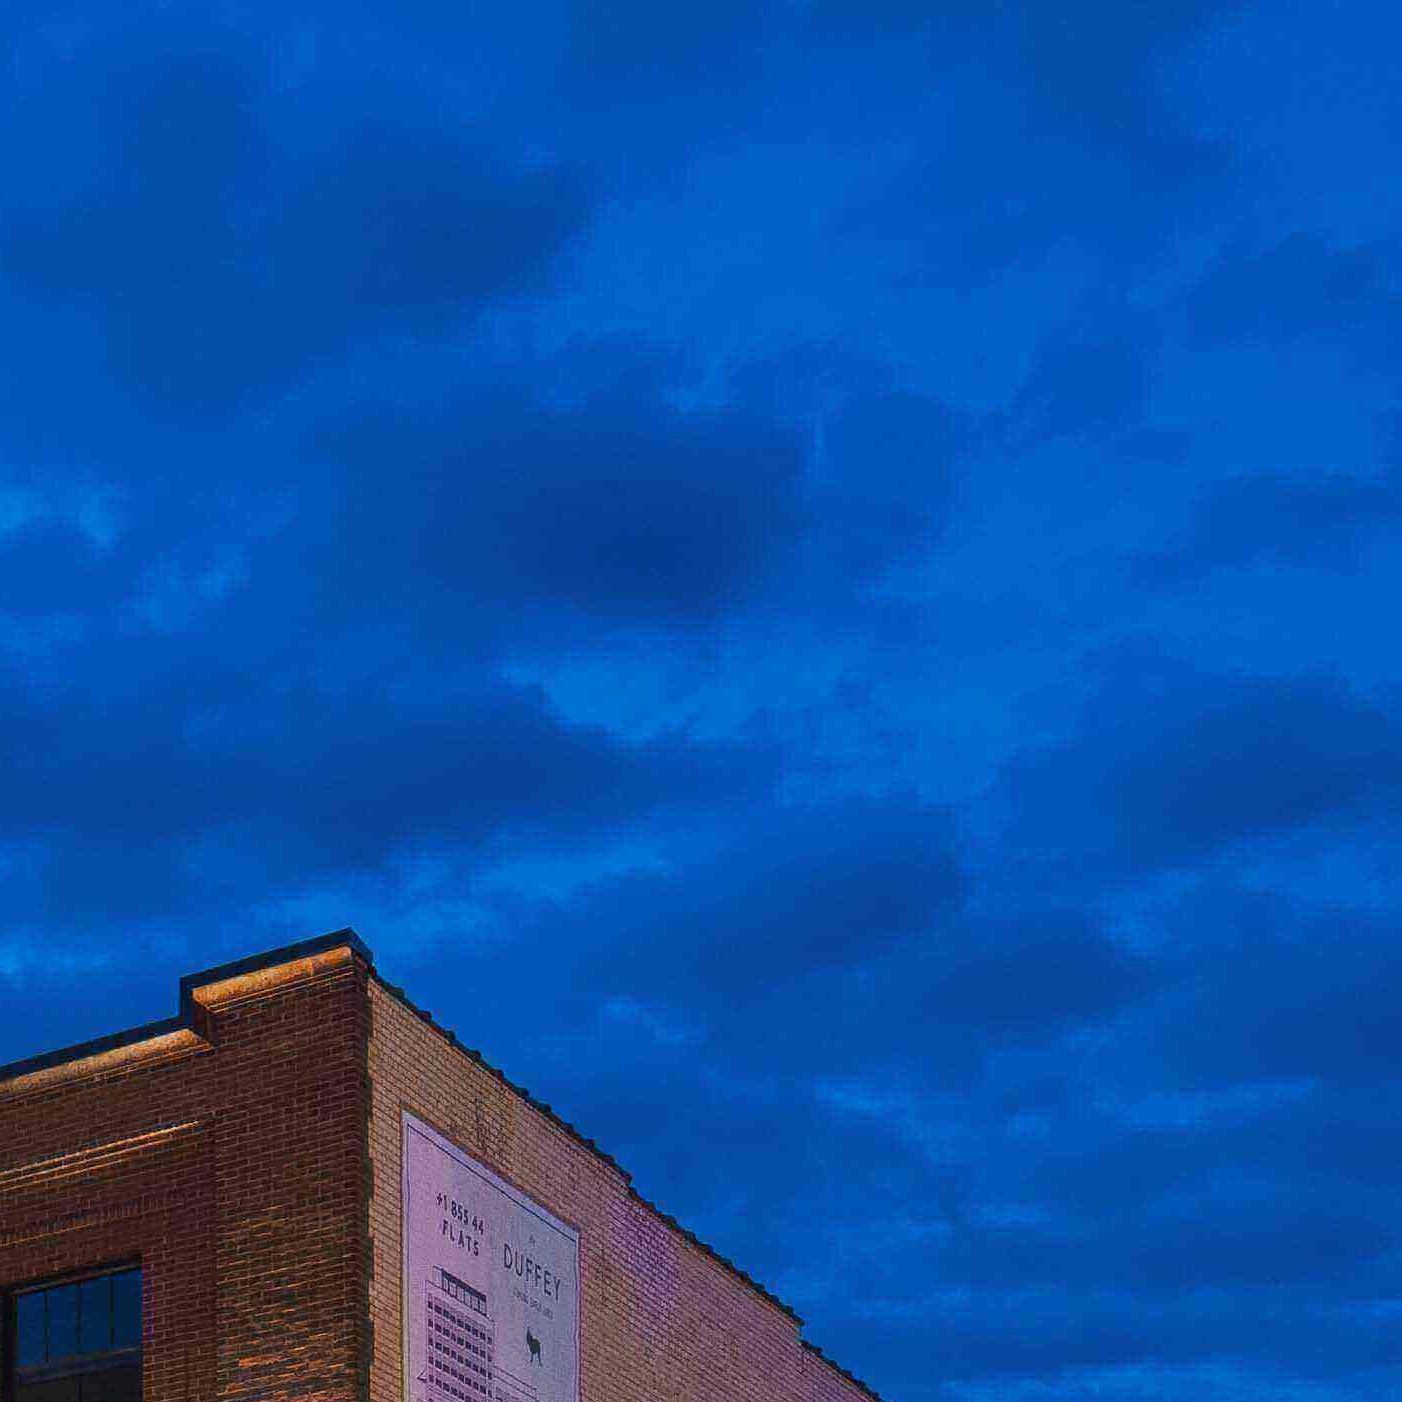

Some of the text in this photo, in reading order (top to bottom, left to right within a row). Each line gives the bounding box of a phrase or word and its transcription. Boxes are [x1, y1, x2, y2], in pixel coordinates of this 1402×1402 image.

[451, 1200, 469, 1226] 855
[442, 1219, 480, 1256] FLATS
[503, 1243, 561, 1302] DUFFEY
